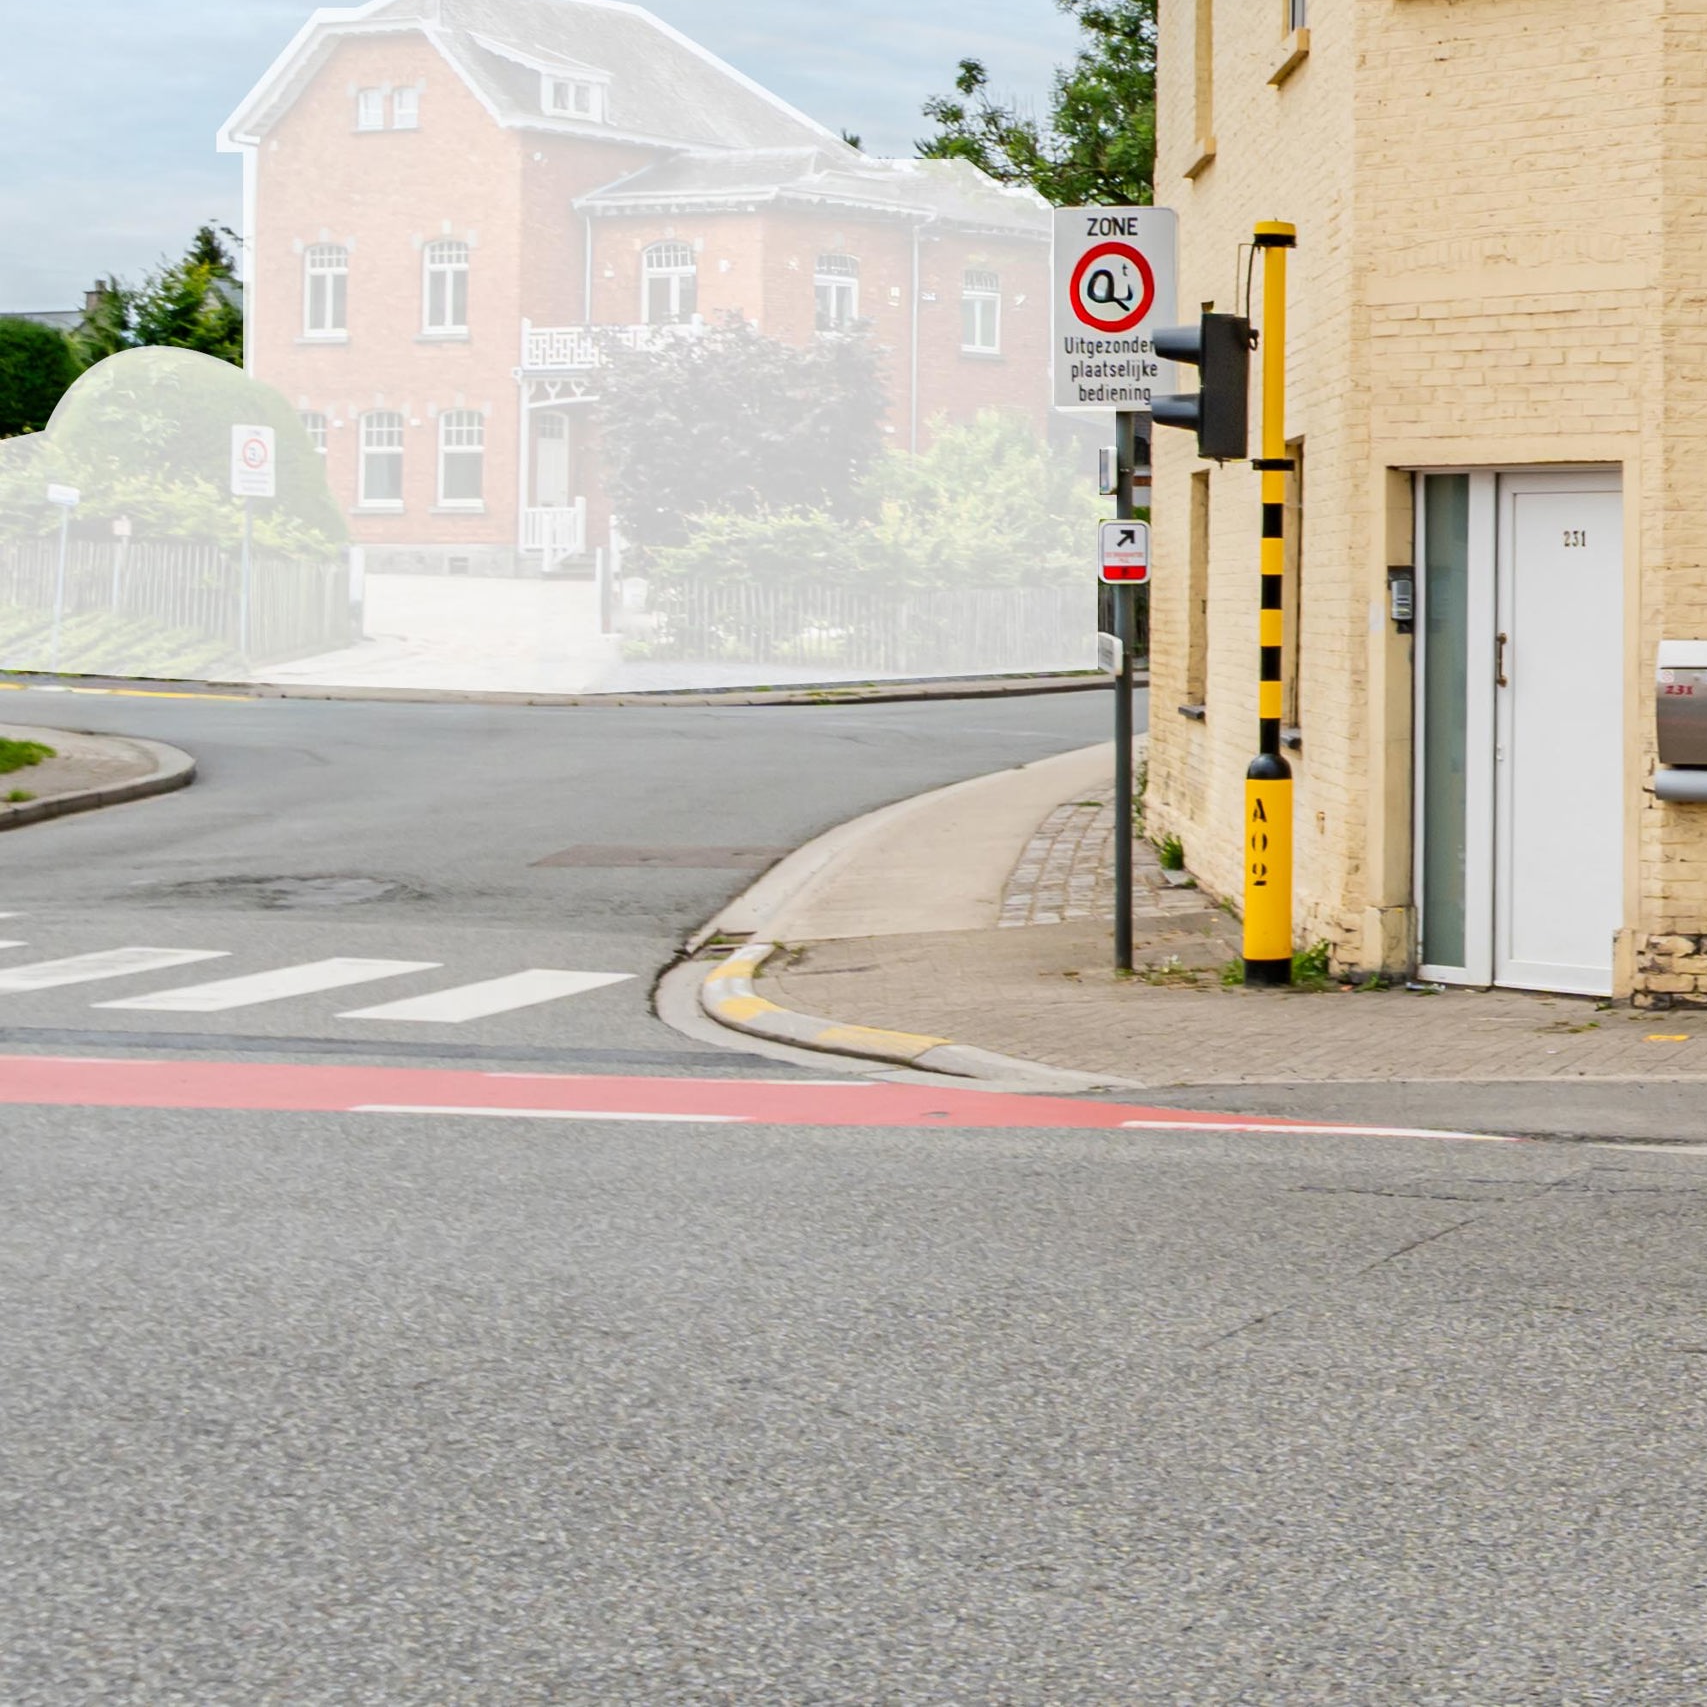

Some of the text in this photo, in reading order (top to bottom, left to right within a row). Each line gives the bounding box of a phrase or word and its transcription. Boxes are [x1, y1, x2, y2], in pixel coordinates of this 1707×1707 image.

[1087, 217, 1138, 236] ZONE
[1064, 336, 1157, 359] Uitgezonder
[1071, 359, 1159, 383] plaatselijke
[1078, 384, 1152, 406] bediening
[1563, 530, 1586, 547] 231
[1664, 684, 1694, 696] 231
